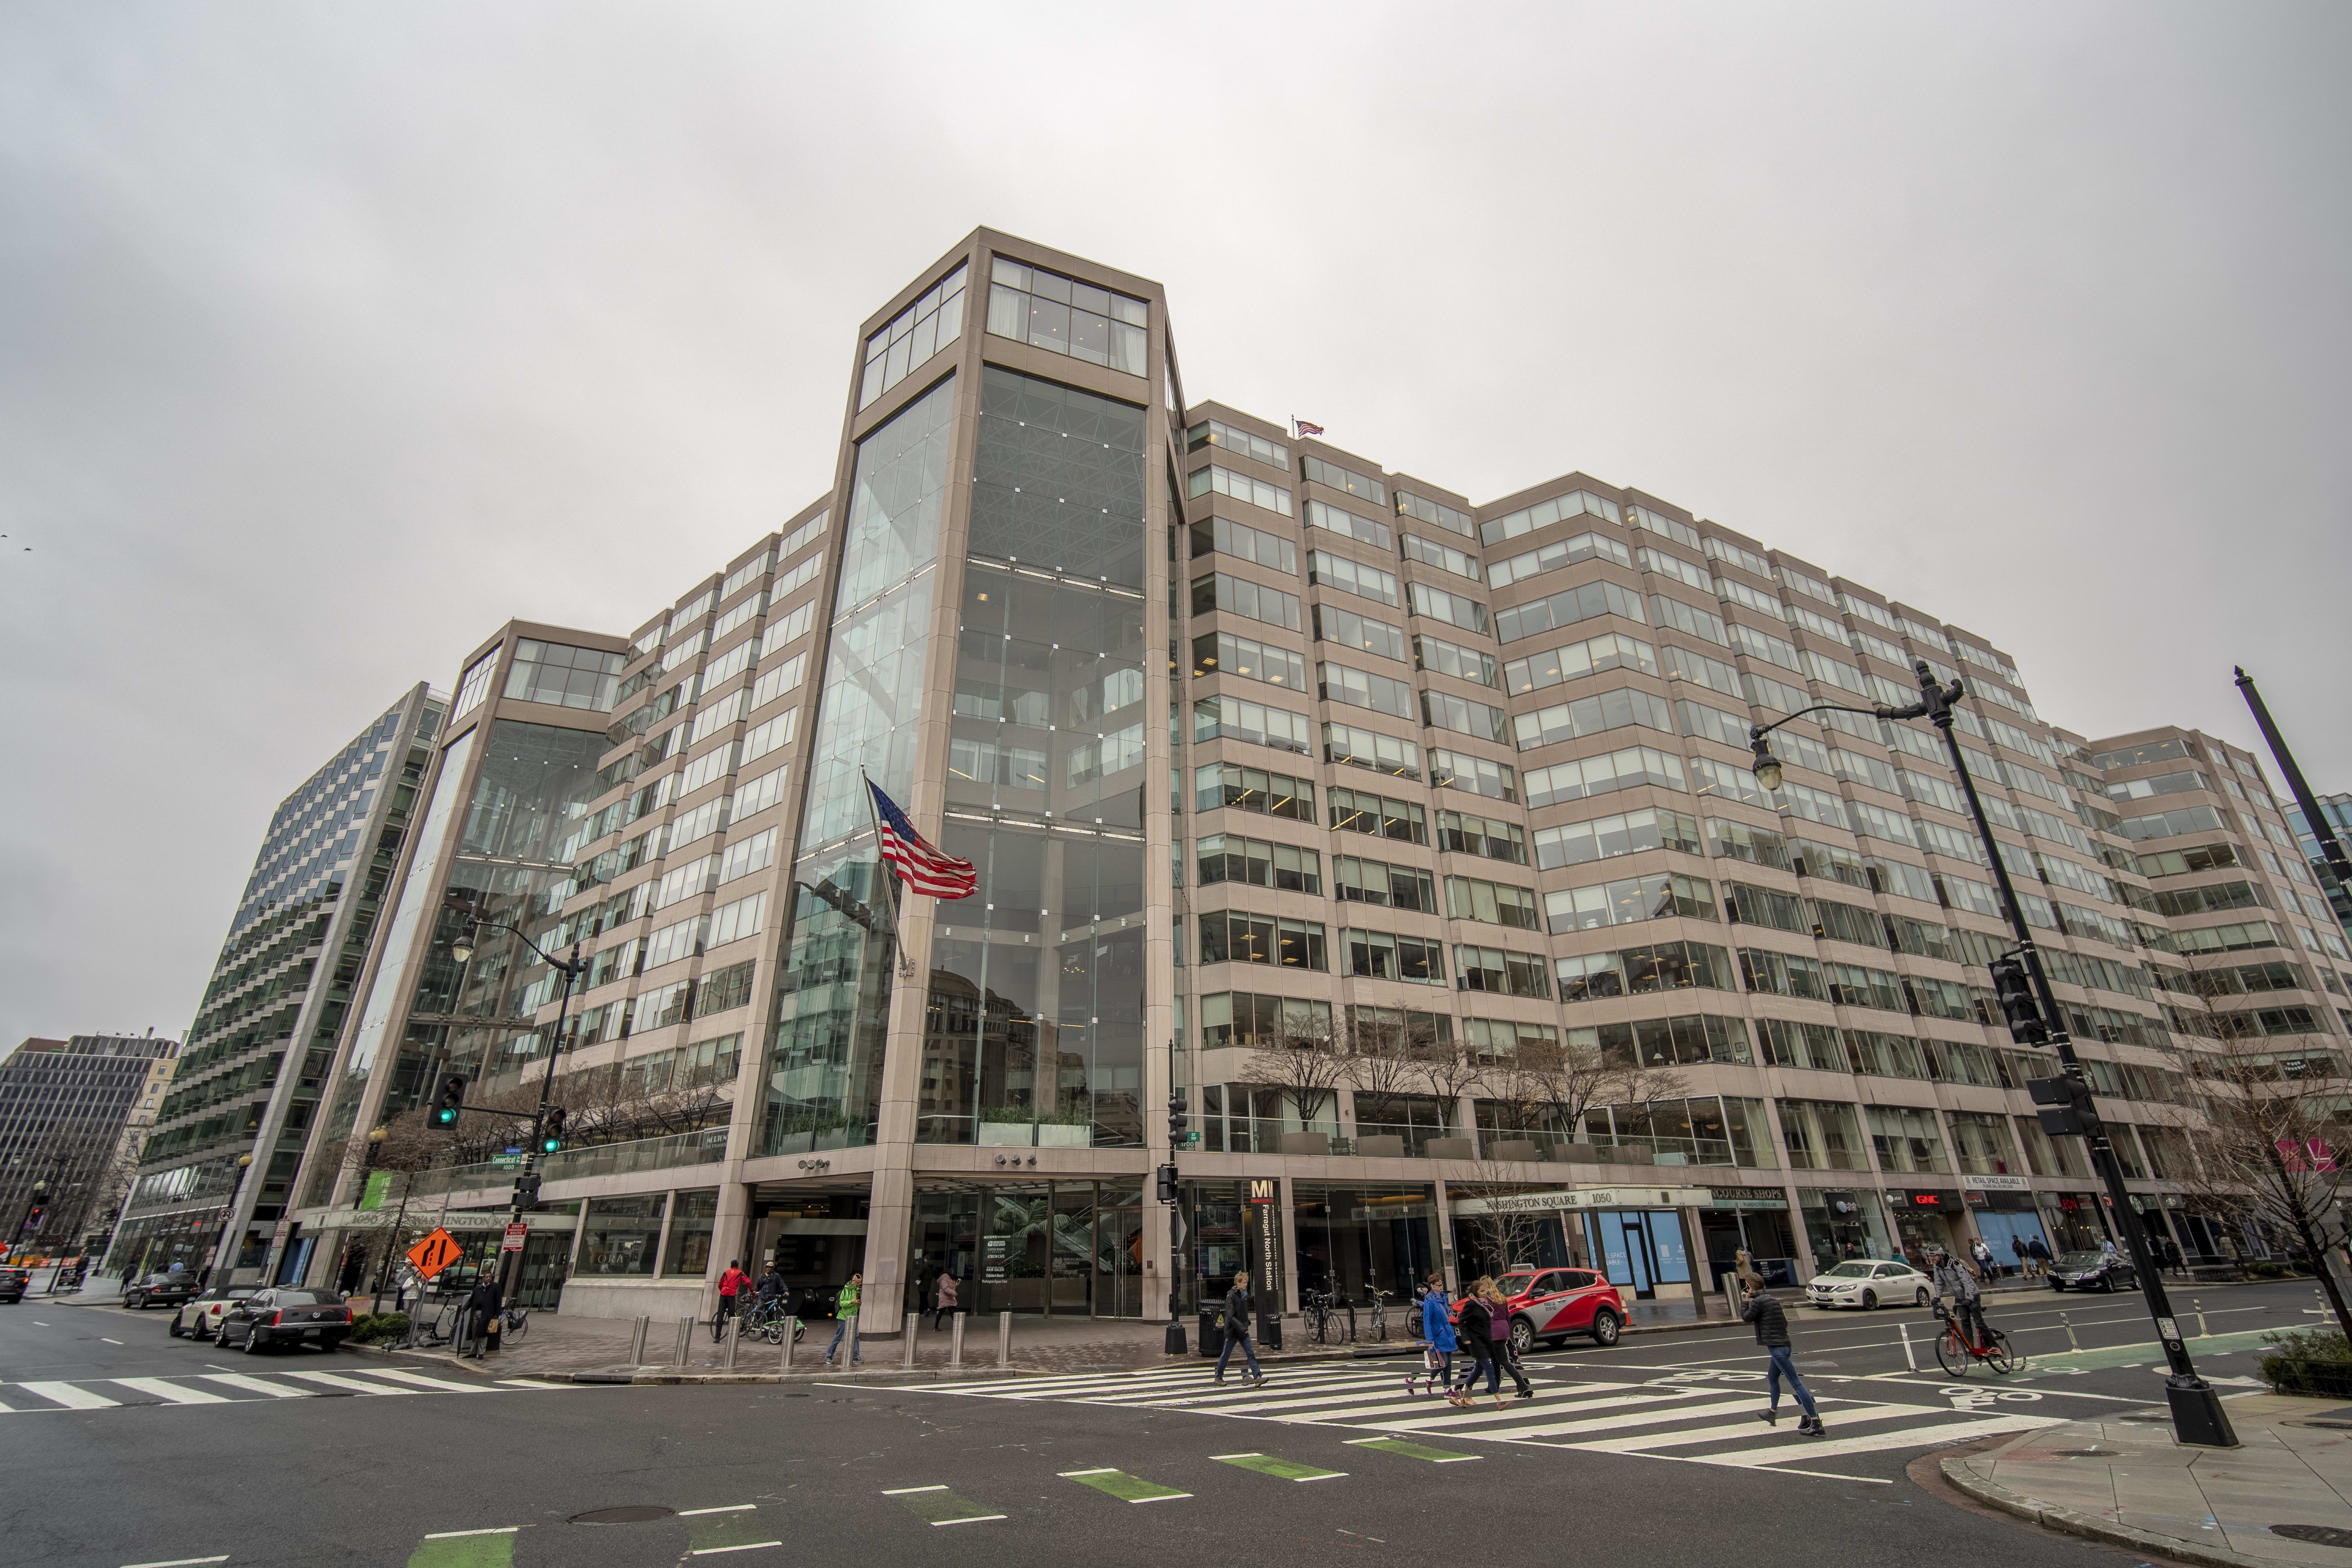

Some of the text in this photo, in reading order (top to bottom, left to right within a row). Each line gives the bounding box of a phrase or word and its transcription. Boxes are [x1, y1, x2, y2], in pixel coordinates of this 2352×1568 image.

[1251, 1181, 1267, 1198] M
[1268, 1181, 1273, 1198] M
[1711, 1188, 1782, 1199] NCOURSE SHOPS
[1487, 1192, 1611, 1209] WASHINGTON SQUARE 1050
[1916, 1195, 1939, 1204] GNC
[353, 1214, 378, 1224] 1050
